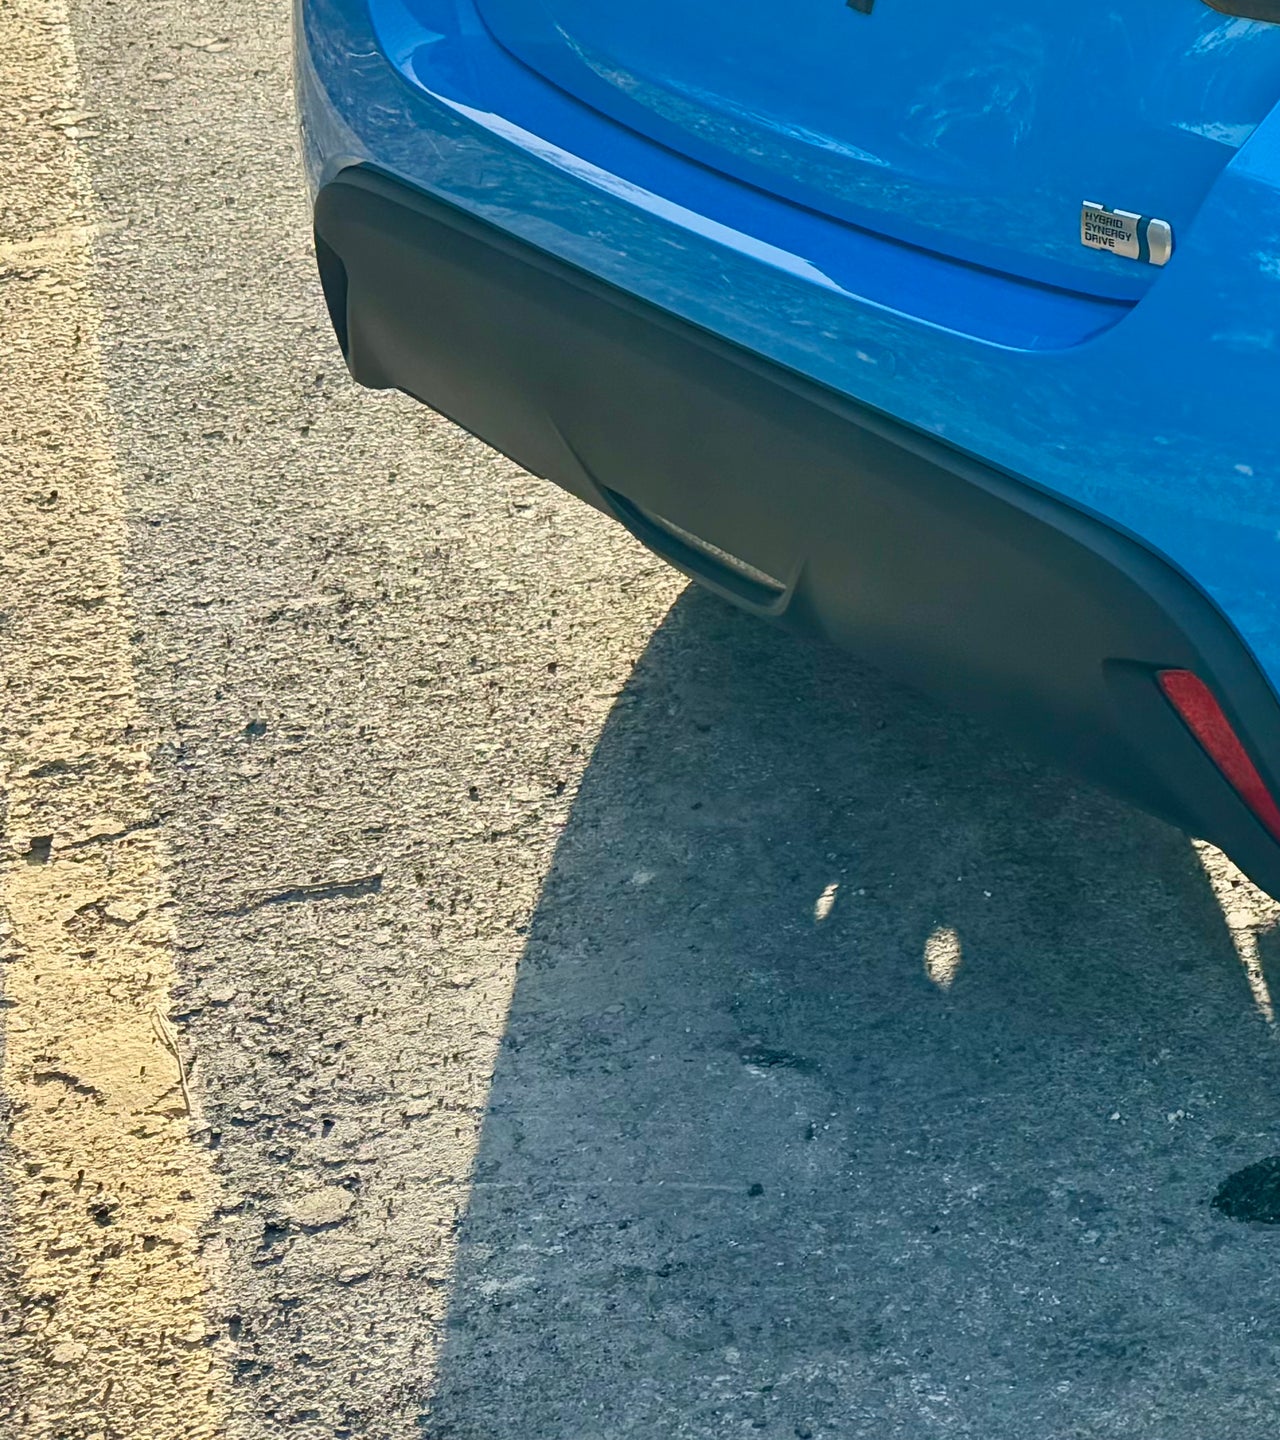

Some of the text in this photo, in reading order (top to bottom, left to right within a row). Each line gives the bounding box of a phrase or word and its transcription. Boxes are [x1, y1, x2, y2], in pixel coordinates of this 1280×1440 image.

[1085, 211, 1123, 229] HYBRID
[1084, 232, 1115, 248] DRIVE
[1085, 222, 1132, 242] SYNERGY
